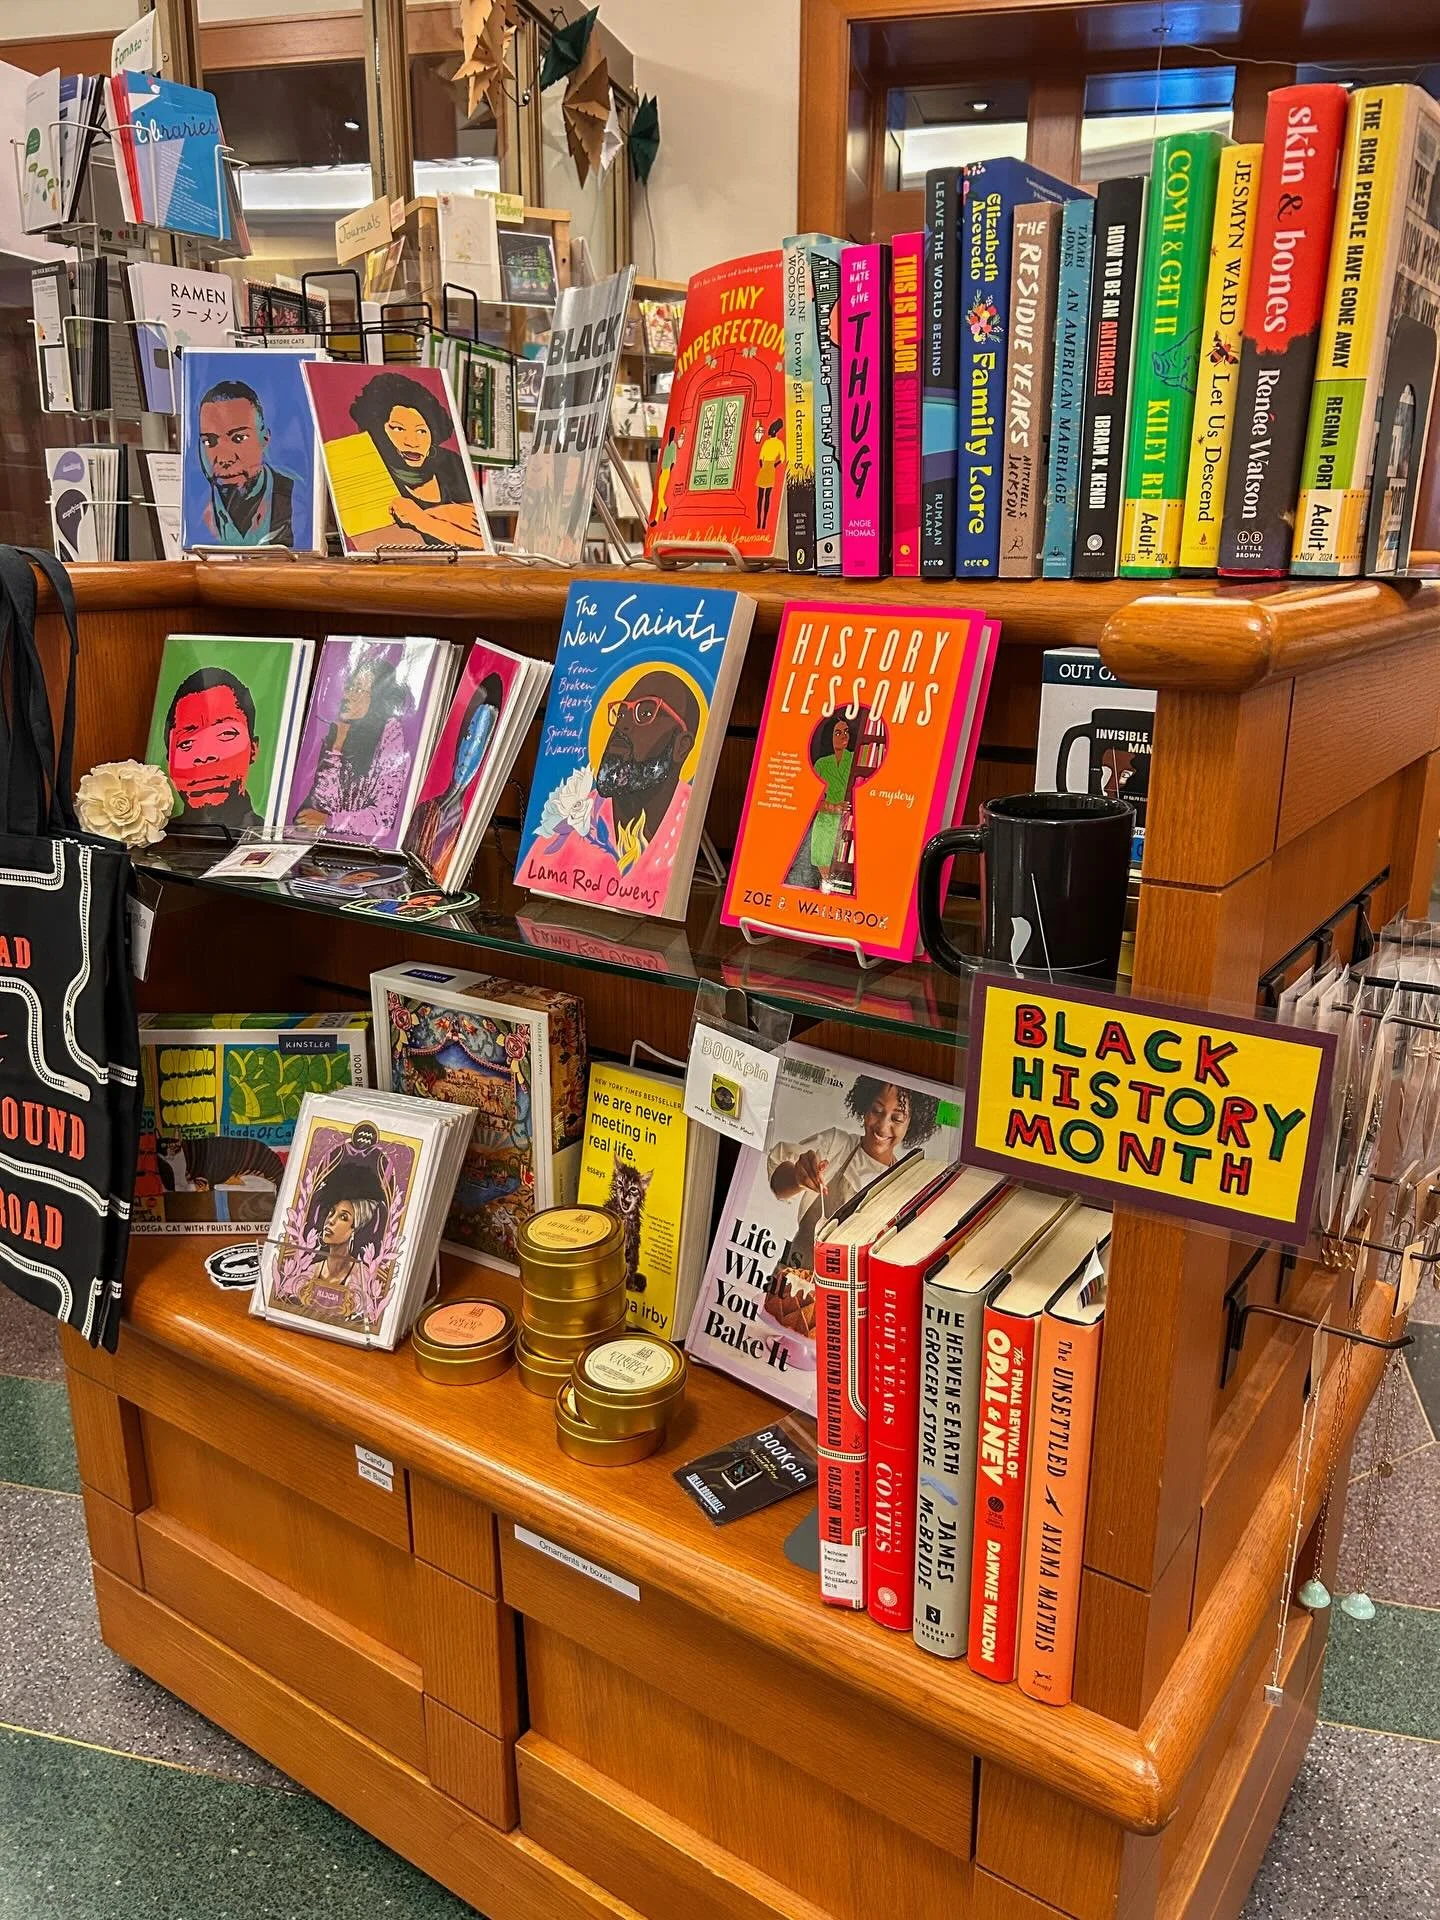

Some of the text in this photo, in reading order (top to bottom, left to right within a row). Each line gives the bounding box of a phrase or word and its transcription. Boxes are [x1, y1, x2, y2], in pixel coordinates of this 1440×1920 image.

[136, 113, 219, 144] libraries
[338, 214, 382, 244] Journals
[970, 200, 985, 280] Acevedo
[984, 193, 1001, 282] Elizabeth
[1016, 221, 1048, 237] THE
[1076, 224, 1088, 268] TAYARI
[1153, 150, 1193, 336] COME & GET IT
[1219, 159, 1252, 326] JESMYN WARD
[1263, 106, 1320, 334] skin & bones
[1331, 98, 1384, 369] THE RICH PEOPLE HAVE GONE AWAY
[852, 259, 868, 271] THE
[1064, 227, 1077, 268] JONES
[170, 282, 227, 305] RAMEN
[720, 285, 765, 315] TINY
[788, 255, 798, 317] WOODSON
[796, 246, 806, 323] JACQUELINE
[850, 270, 870, 283] HATE
[850, 292, 870, 308] GIVE
[857, 283, 863, 292] U
[932, 181, 945, 377] LEAVE THE WORLD BEHIND
[171, 303, 229, 325] ラーメン
[819, 258, 832, 385] THE MOTHERS
[894, 255, 918, 373] THIS IS MAJOR
[1097, 225, 1126, 397] HOW TO BE AN ANTIRACIST
[547, 312, 622, 366] BLACK
[677, 318, 785, 377] IMPERFECTION
[1008, 242, 1042, 448] RESIDUE YEARS
[589, 361, 613, 404] IS
[793, 332, 806, 469] brown girl dreaming
[848, 311, 873, 499] THUG
[1055, 288, 1080, 505] AN AMERICAN MARRIAGE
[1210, 374, 1231, 405] Let
[965, 352, 996, 535] Family Lore
[1206, 414, 1226, 437] Us
[1241, 368, 1281, 519] Renée Watson
[1320, 396, 1344, 449] REGINA
[821, 404, 834, 530] BRIT BENNETT
[1005, 453, 1023, 518] JACKSON
[1088, 415, 1112, 509] IBRAM X. KENDI
[1198, 446, 1222, 522] Descend
[845, 529, 876, 537] THOMAS
[849, 519, 872, 528] ANGIE
[925, 504, 933, 537] ALAM
[934, 493, 943, 546] RUMAAN
[1138, 512, 1158, 556] Adult
[1308, 504, 1332, 551] Adult
[1299, 552, 1333, 561] NOV 2024
[574, 594, 598, 618] The
[600, 594, 725, 654] Saints
[563, 622, 607, 648] New
[791, 623, 951, 675] HISTORY
[558, 677, 597, 692] Broken
[567, 660, 598, 676] From
[1059, 664, 1095, 679] OUT
[559, 693, 593, 714] Hearts
[563, 712, 574, 724] to
[780, 671, 940, 727] LESSONS
[545, 726, 582, 745] Spiritual
[545, 743, 587, 761] Warriors
[1095, 728, 1149, 743] INVISIBLE
[1127, 742, 1153, 755] MAN
[869, 788, 916, 809] a mystery
[527, 858, 661, 909] Lama Rod Owens
[285, 1041, 332, 1049] KINSTLER
[701, 1035, 769, 1083] BOOKpin
[1013, 1003, 1239, 1088] BLACK
[593, 1091, 673, 1127] we are never
[595, 1077, 682, 1110] NEW YORK TIMES BESTSELLER
[1011, 1056, 1307, 1162] HISTORY
[2, 1096, 87, 1162] OUND
[588, 1135, 637, 1162] real life.
[591, 1112, 657, 1145] meeting in
[1004, 1108, 1253, 1196] MONTH
[207, 1224, 233, 1232] FRUITS
[236, 1224, 251, 1232] AND
[728, 1218, 804, 1269] Life Is
[725, 1247, 789, 1300] What
[642, 1302, 669, 1329] irby
[715, 1277, 759, 1323] You
[924, 1303, 965, 1329] THE
[704, 1308, 792, 1372] Bake It
[826, 1249, 842, 1447] THE UNDERGROUND RAILROAD
[882, 1288, 897, 1426] EIGHT YEARS
[985, 1328, 1011, 1404] OPAL
[922, 1327, 940, 1468] GROCERY STORE
[943, 1331, 965, 1475] HEAVEN & EARTH
[987, 1409, 1001, 1422] &
[1006, 1346, 1026, 1479] The FINAL REVIVAL OF
[1046, 1341, 1074, 1478] The UNSETTLED
[364, 1451, 387, 1470] Candy
[756, 1431, 808, 1483] BOOKpin
[981, 1422, 1006, 1486] NEV
[875, 1461, 893, 1554] COATES
[539, 1540, 614, 1585] Ornaments w boxes
[918, 1494, 935, 1592] McBRIDE
[936, 1515, 957, 1584] JAMES
[1039, 1521, 1063, 1579] AYANA
[824, 1567, 847, 1577] FICTION
[983, 1539, 1002, 1602] DAWNIE
[922, 1630, 945, 1644] BOOKS
[981, 1602, 999, 1663] WALTON
[1035, 1584, 1059, 1653] MATHIS
